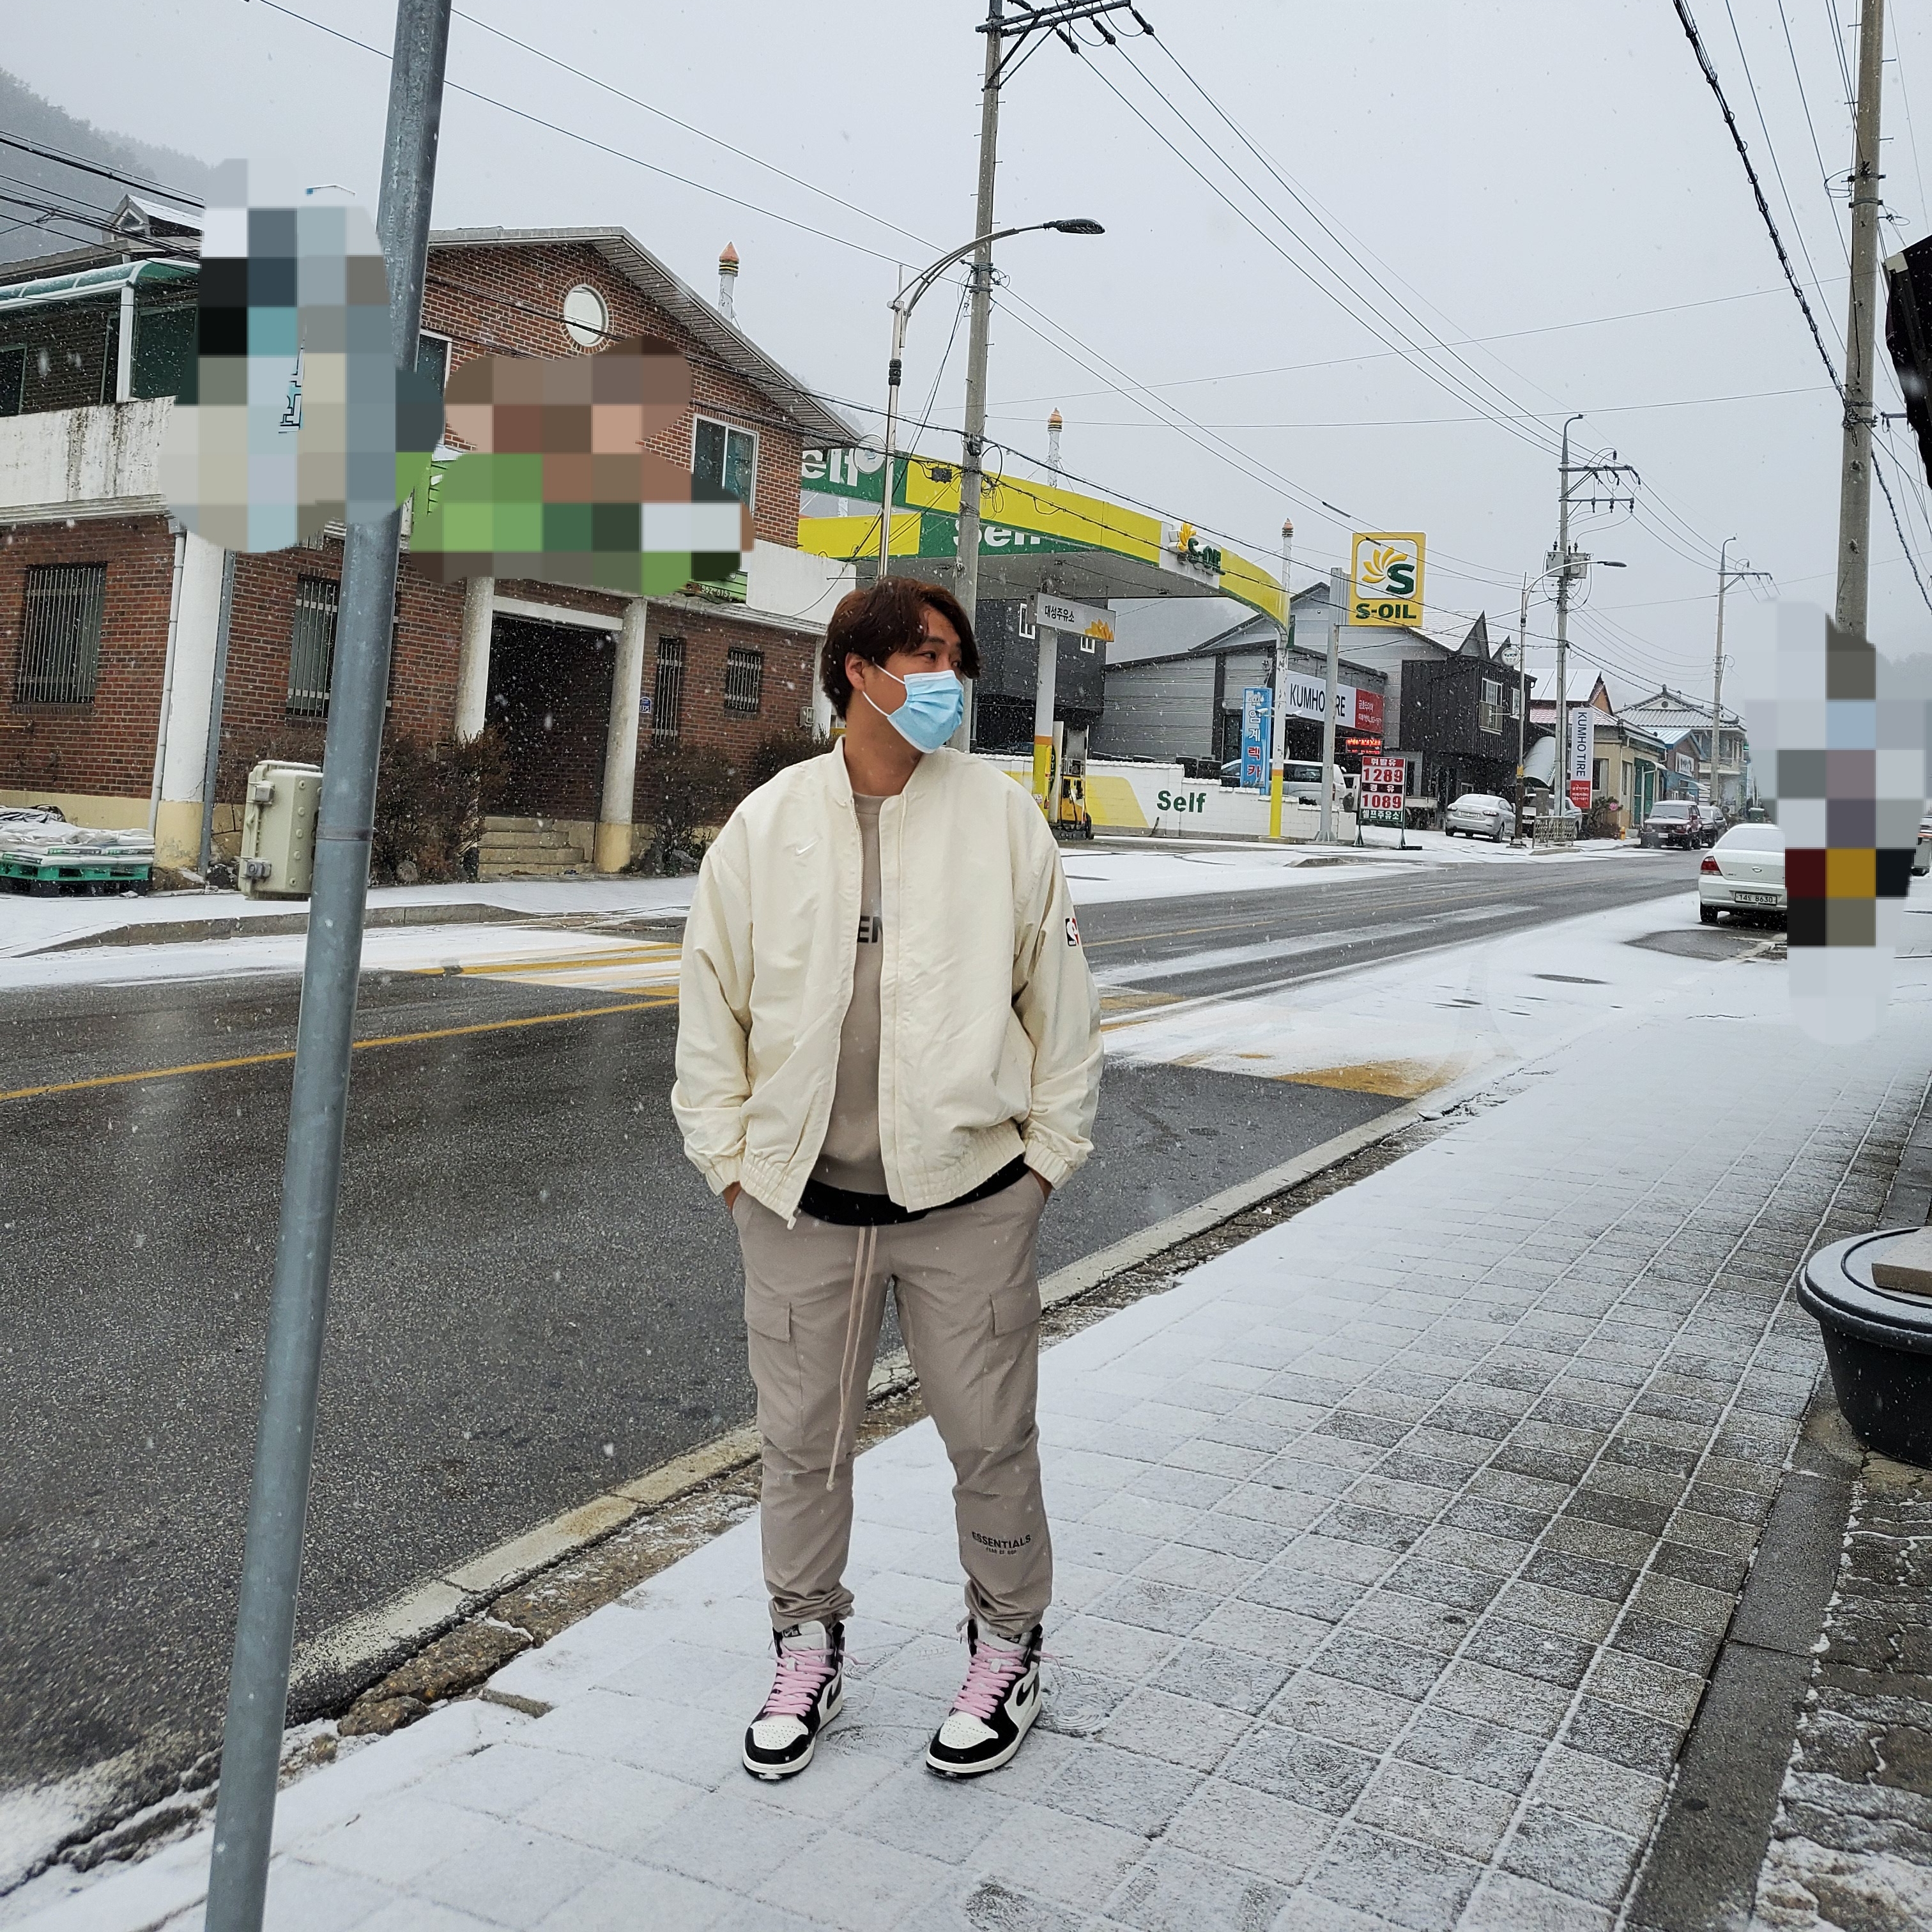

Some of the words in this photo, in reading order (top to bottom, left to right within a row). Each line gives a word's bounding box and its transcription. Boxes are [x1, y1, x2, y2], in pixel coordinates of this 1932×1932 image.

[801, 448, 859, 487] elf
[1045, 604, 1075, 623] 대성주유소
[1355, 602, 1417, 620] S-OIL
[1290, 683, 1326, 713] KUMHO
[1336, 694, 1346, 717] RE
[1248, 709, 1261, 742] 임계
[1577, 712, 1587, 752] KUMHO
[1247, 746, 1261, 778] 렉카
[1576, 754, 1586, 777] TIRE
[1363, 768, 1404, 783] 1289
[1156, 790, 1207, 813] Self
[1362, 794, 1402, 809] 1089
[1362, 809, 1400, 820] 셀프주유소
[972, 1531, 1031, 1549] ESSENTIALS
